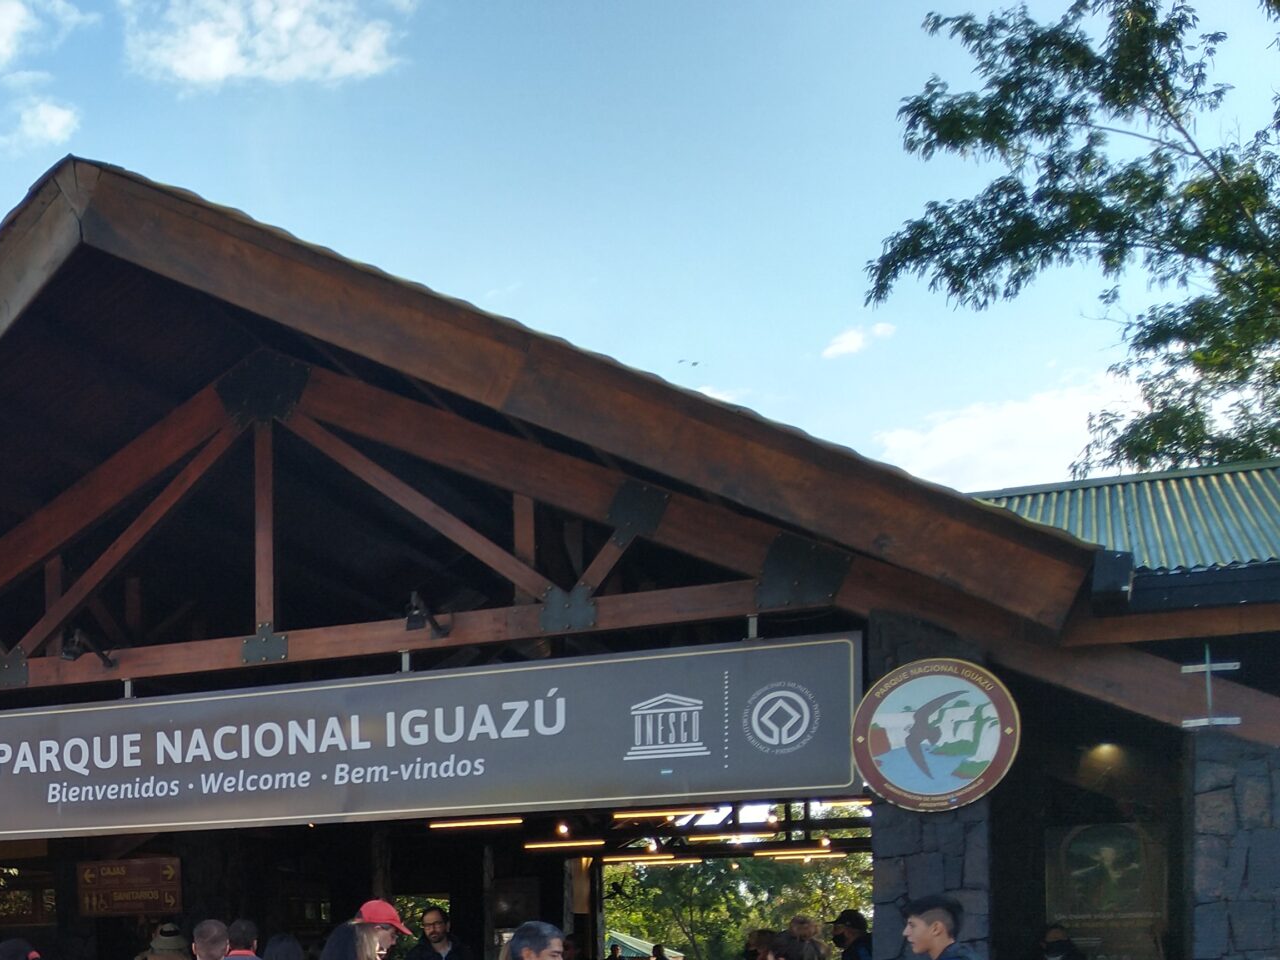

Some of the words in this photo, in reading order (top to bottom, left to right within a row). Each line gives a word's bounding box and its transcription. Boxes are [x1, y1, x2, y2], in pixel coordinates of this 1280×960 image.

[875, 671, 910, 698] PARQUE
[910, 664, 959, 676] NACIONAL
[156, 715, 371, 766] NACIONAL
[386, 687, 566, 748] IGUAZÚ
[634, 711, 700, 746] UNESCO
[47, 776, 180, 803] Bienvenidos
[201, 770, 311, 794] Welcome
[334, 754, 486, 785] Bem-vindos
